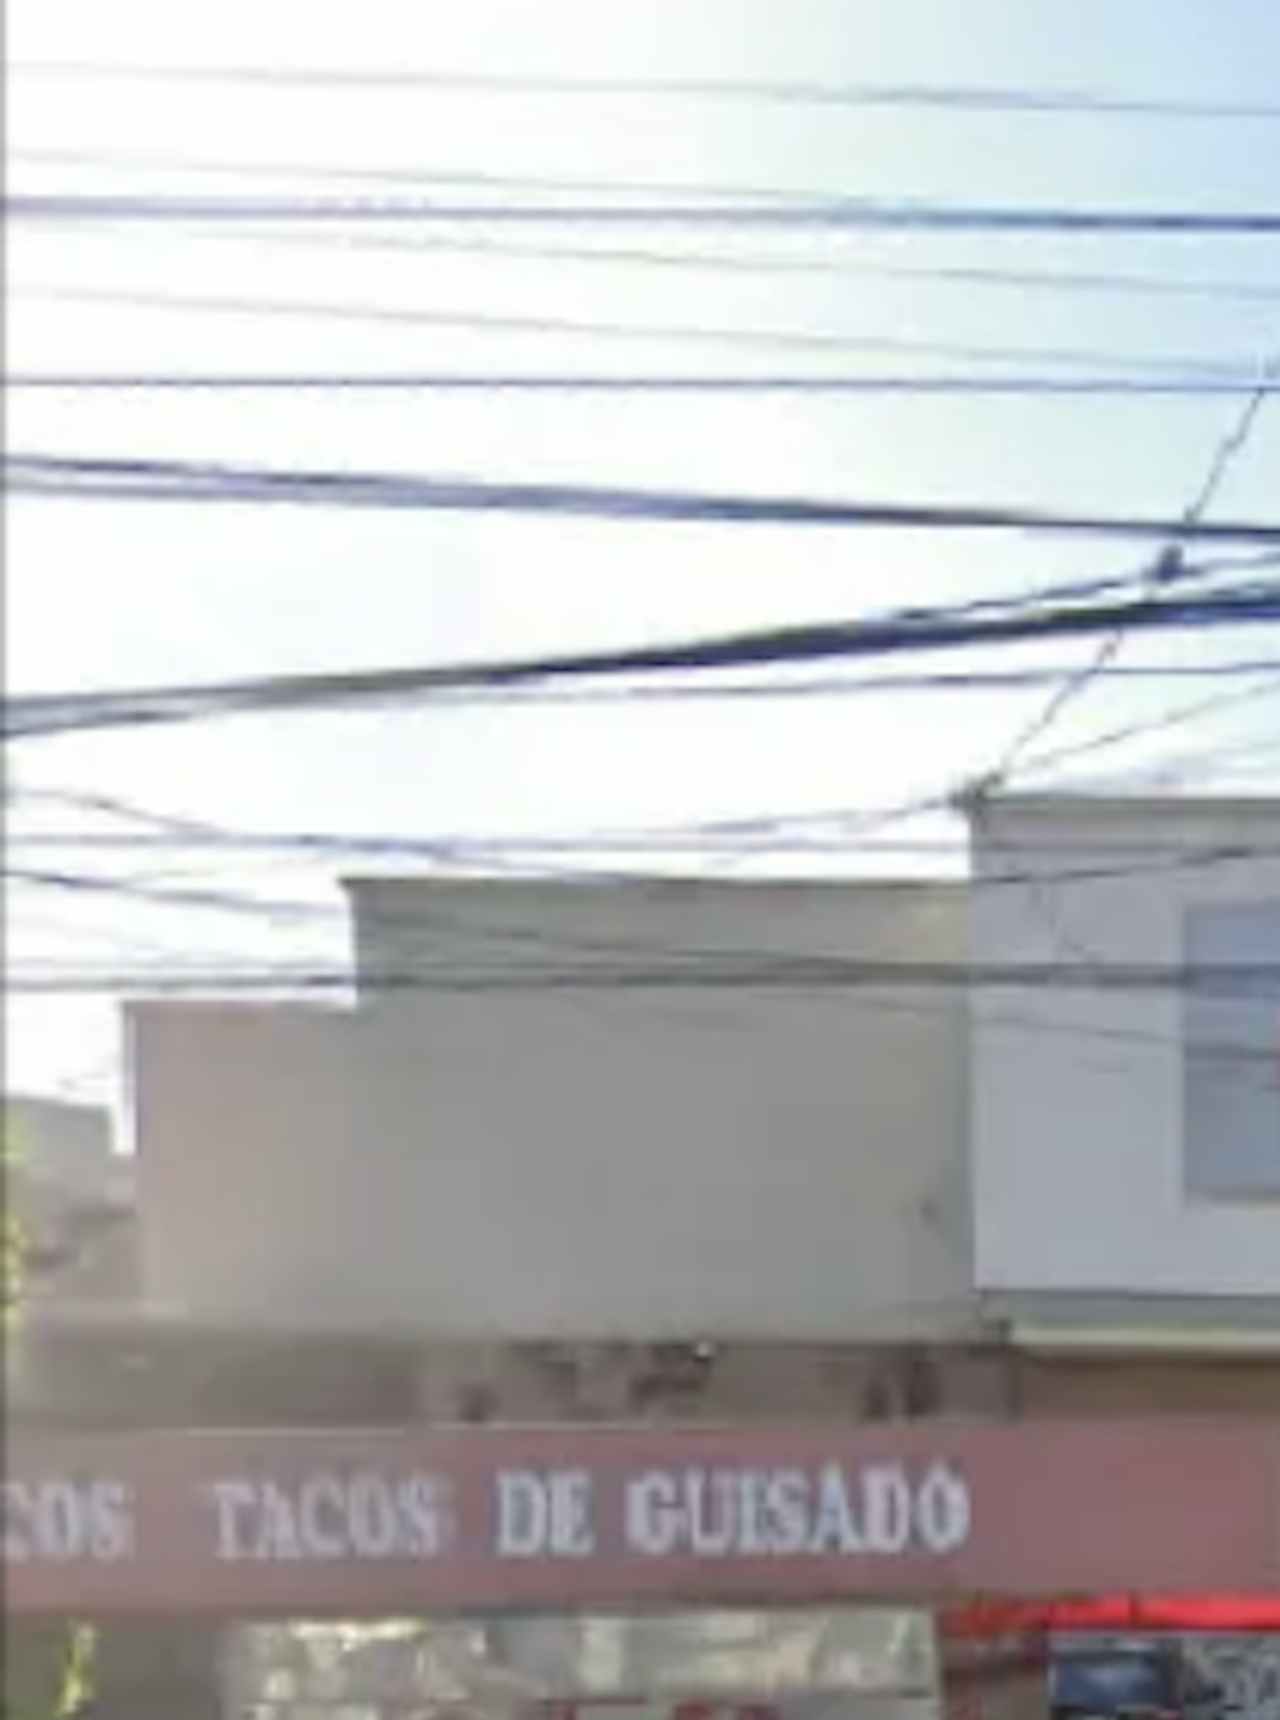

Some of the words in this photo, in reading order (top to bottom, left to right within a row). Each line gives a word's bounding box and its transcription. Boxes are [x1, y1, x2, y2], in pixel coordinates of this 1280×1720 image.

[212, 1472, 440, 1560] TACOS
[496, 1468, 595, 1556] DE
[627, 1460, 971, 1556] GUISADO
